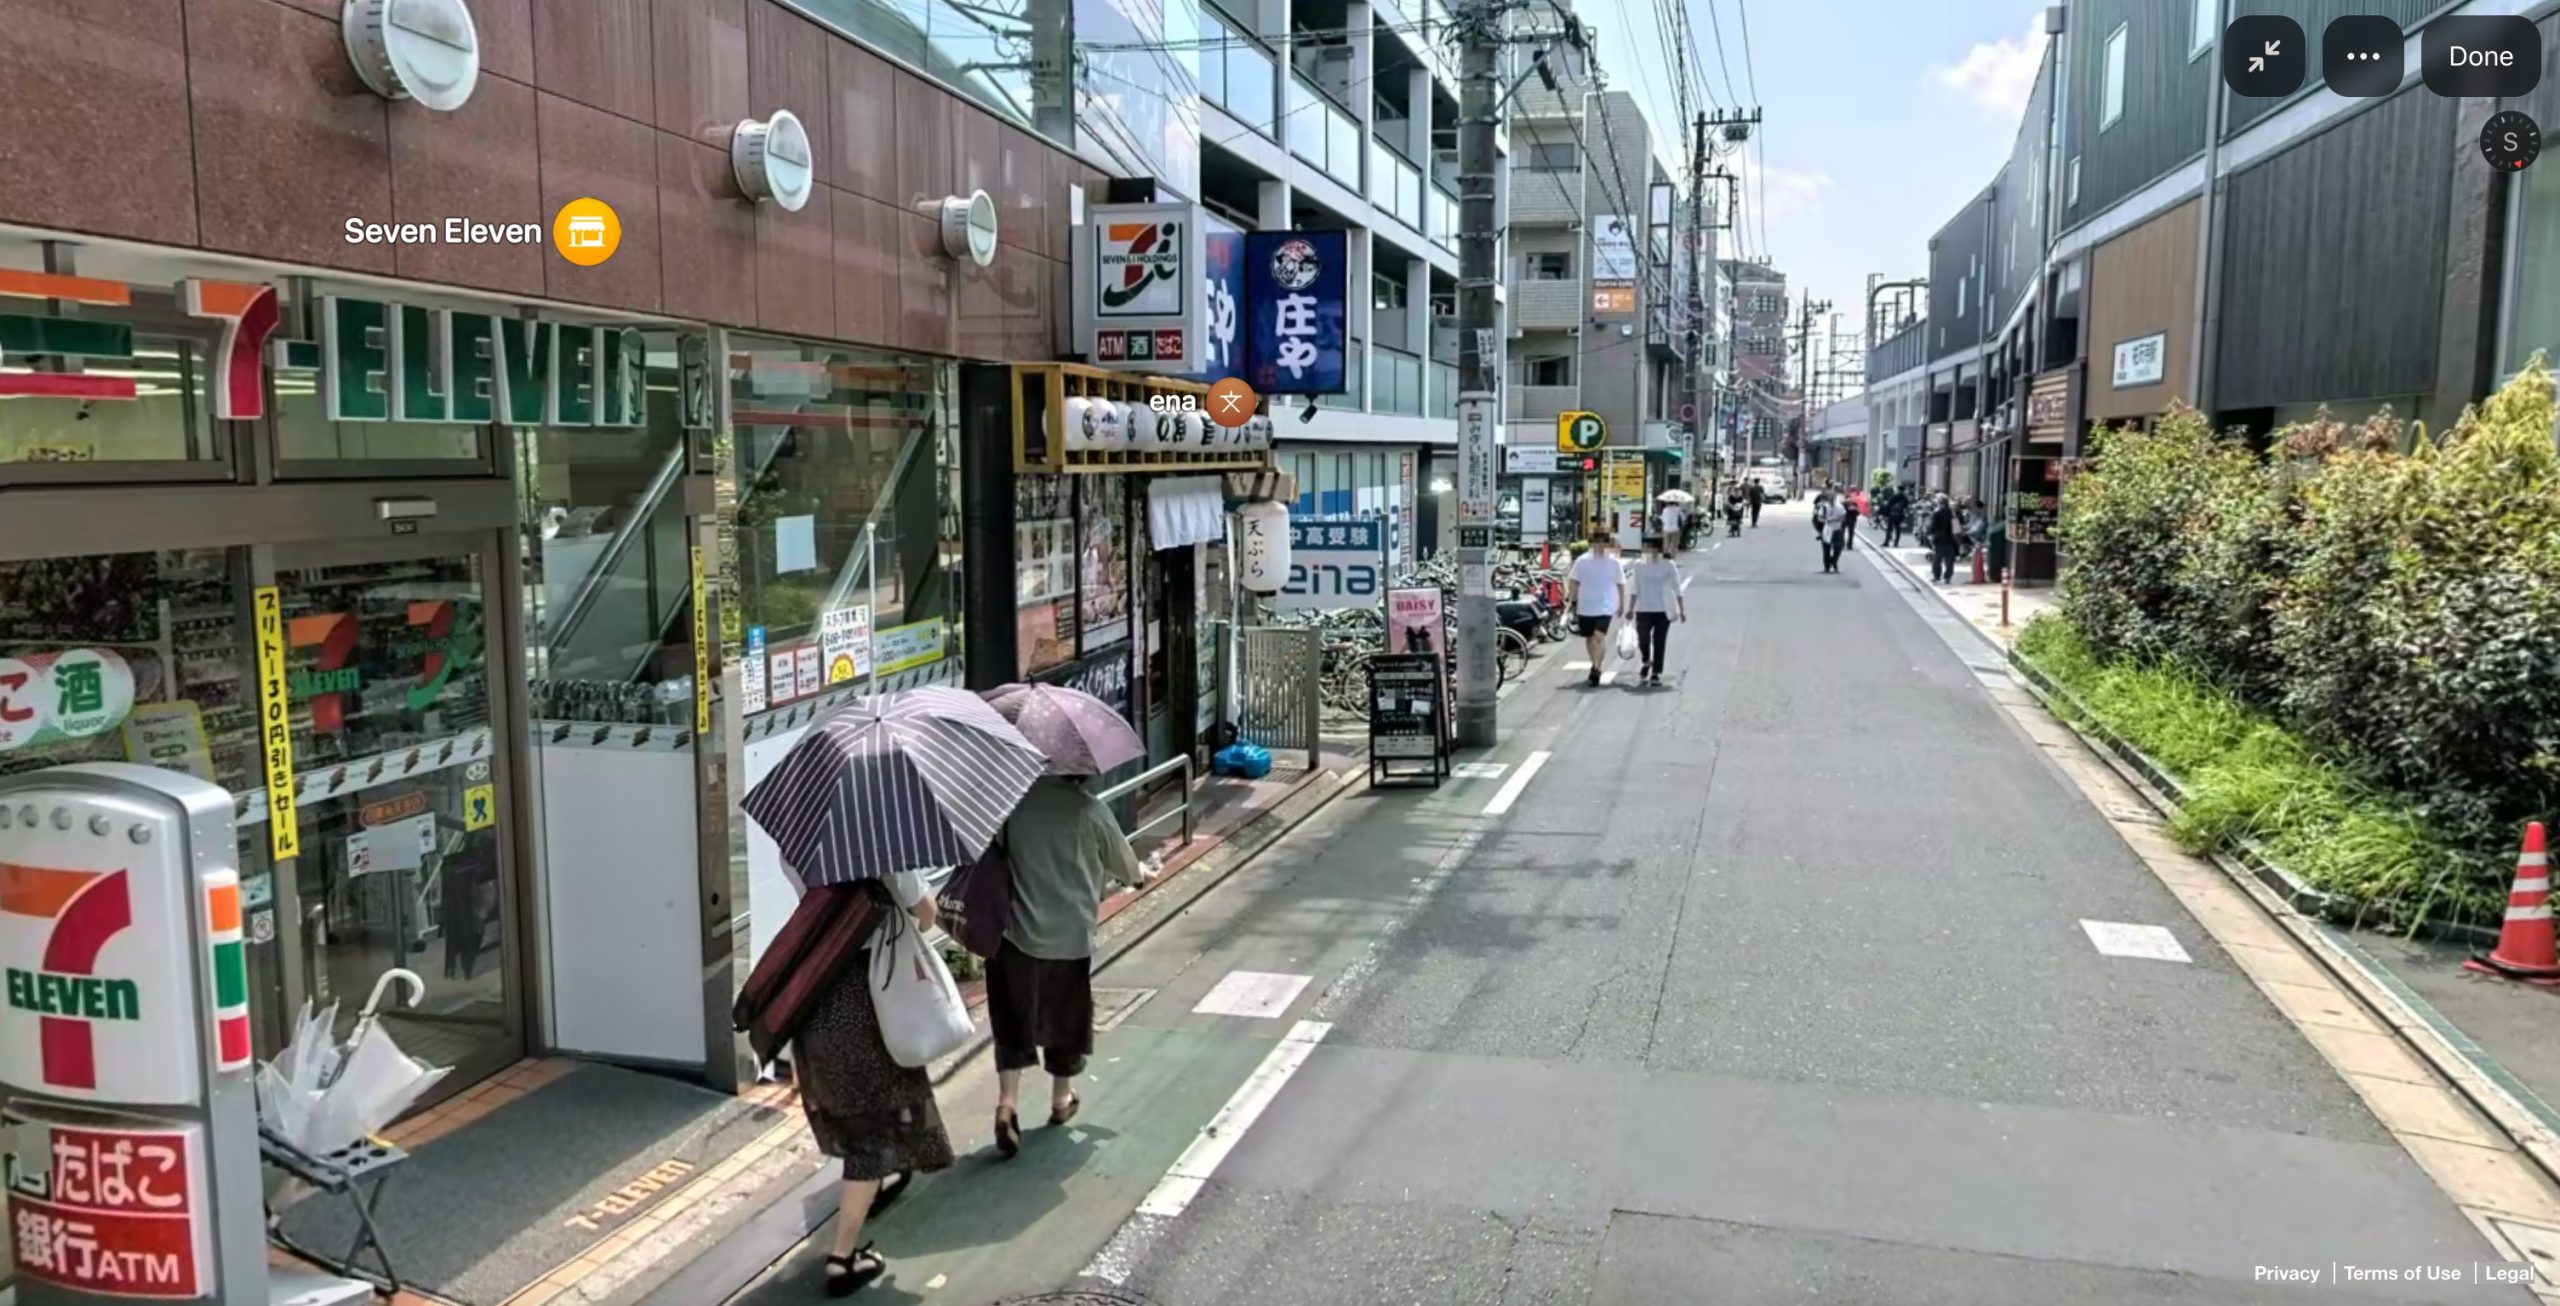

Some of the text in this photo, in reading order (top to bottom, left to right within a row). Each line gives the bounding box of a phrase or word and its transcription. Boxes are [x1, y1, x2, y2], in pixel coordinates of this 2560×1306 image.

[1099, 336, 1124, 356] ATM
[1130, 335, 1149, 356] 酒
[1275, 293, 1318, 380] 庄や
[1579, 420, 1600, 446] P
[1289, 526, 1369, 546] 中高受験
[1396, 600, 1436, 613] DAISY
[54, 660, 104, 717] 酒
[63, 714, 107, 733] liquor
[53, 1135, 183, 1208] たばこ
